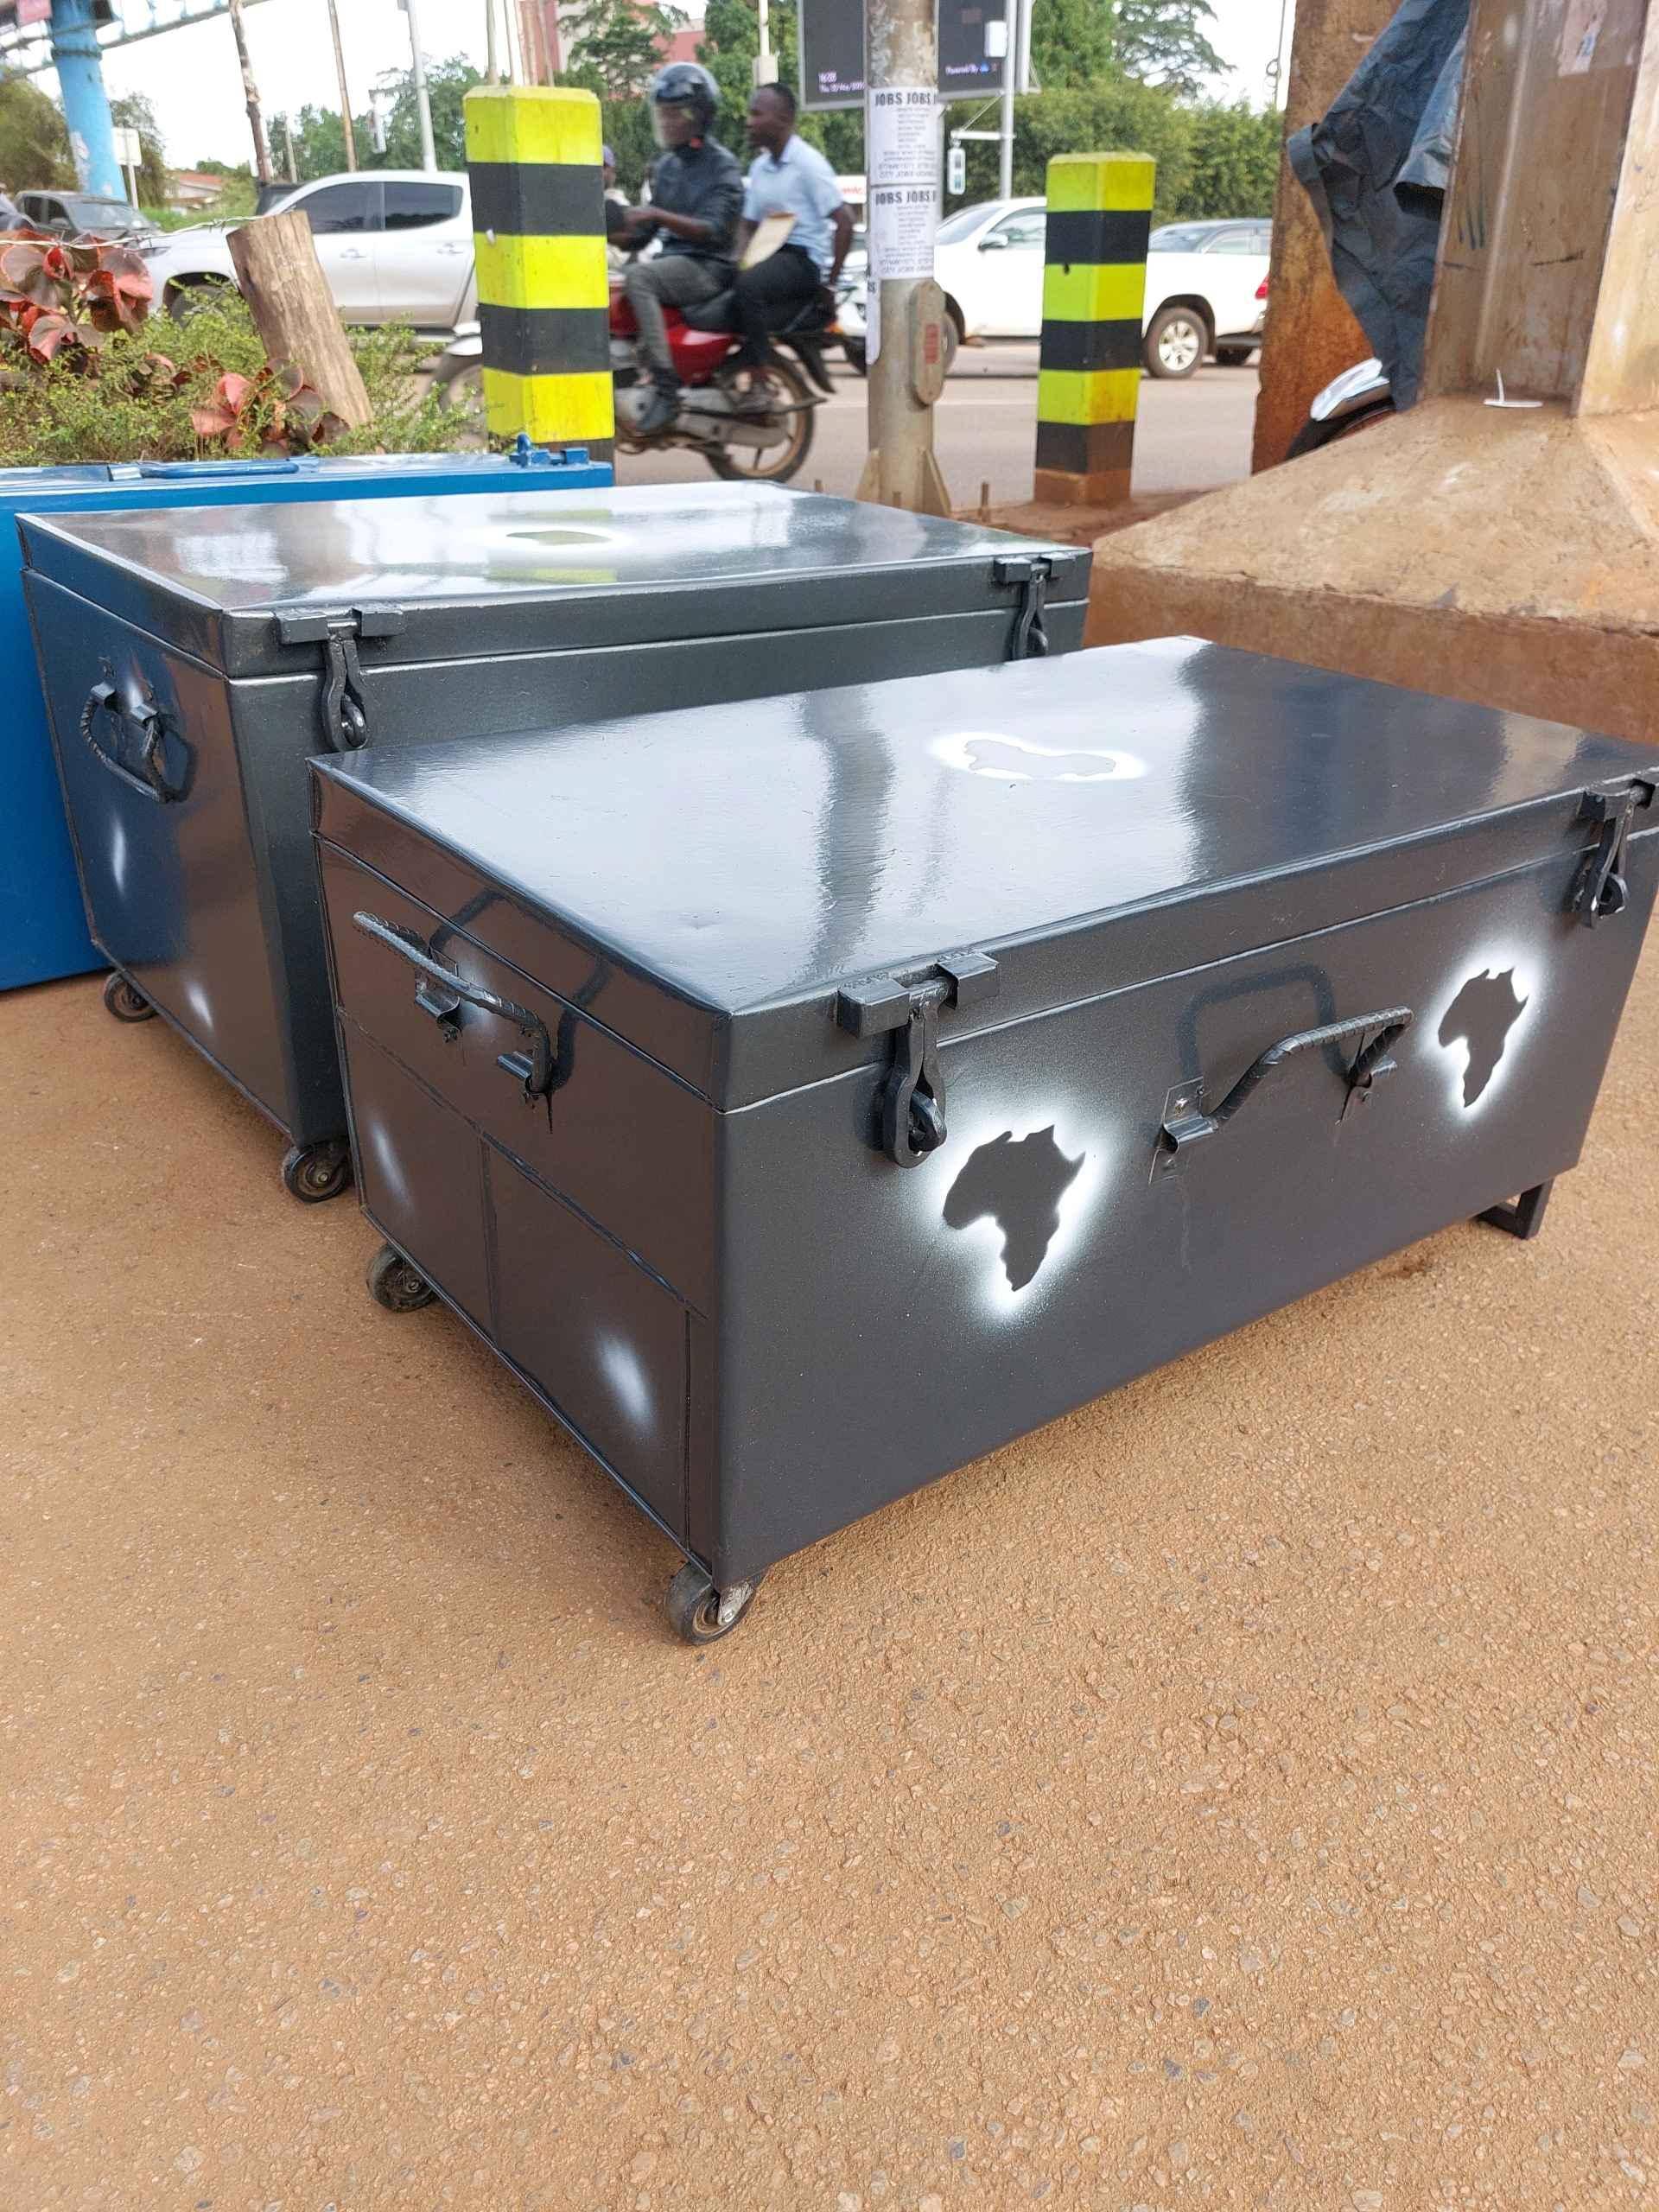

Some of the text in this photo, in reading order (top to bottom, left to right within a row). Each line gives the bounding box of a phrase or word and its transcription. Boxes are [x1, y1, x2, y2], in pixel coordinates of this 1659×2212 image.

[875, 92, 903, 106] JOBS
[907, 92, 931, 105] JOBS
[875, 192, 903, 206] JOBS
[906, 190, 930, 203] JOBS
